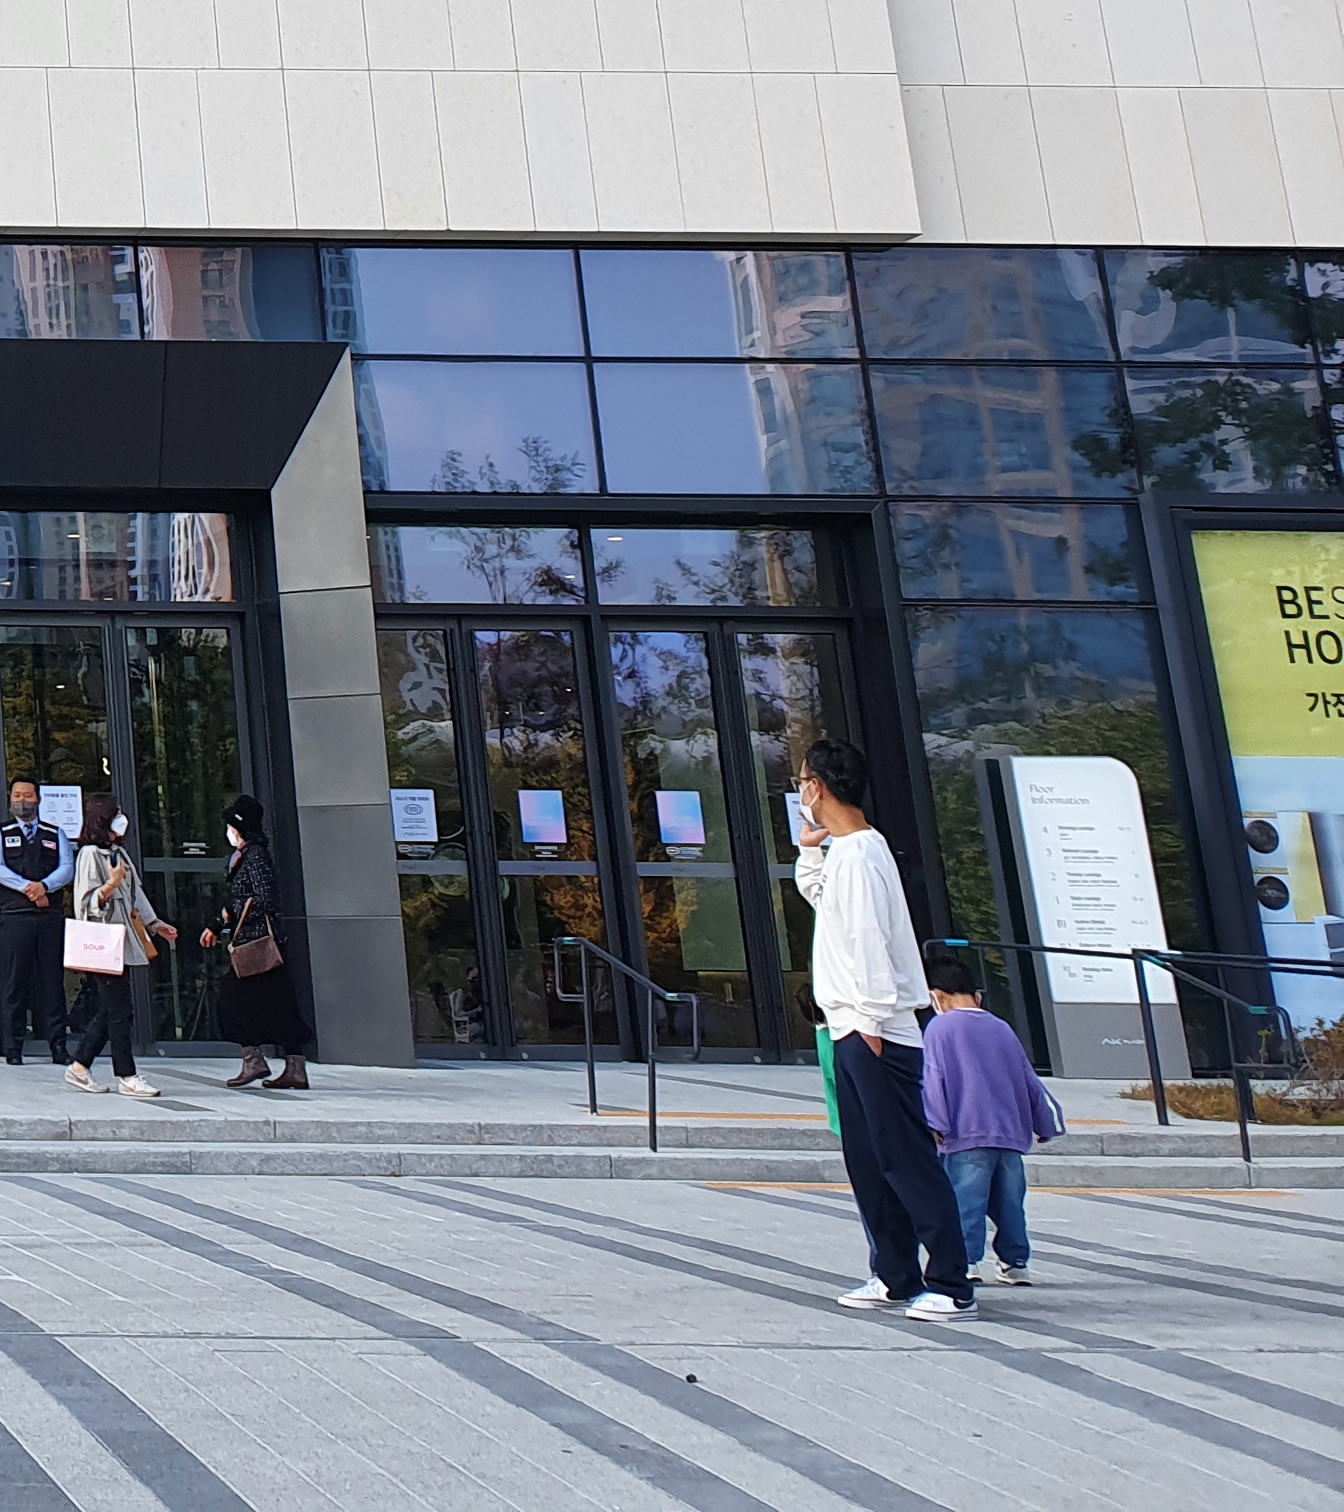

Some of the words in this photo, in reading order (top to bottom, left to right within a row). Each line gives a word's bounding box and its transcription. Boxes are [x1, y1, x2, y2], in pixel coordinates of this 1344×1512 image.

[1283, 629, 1343, 665] HO
[1029, 784, 1055, 793] Floor
[1031, 795, 1090, 805] Information
